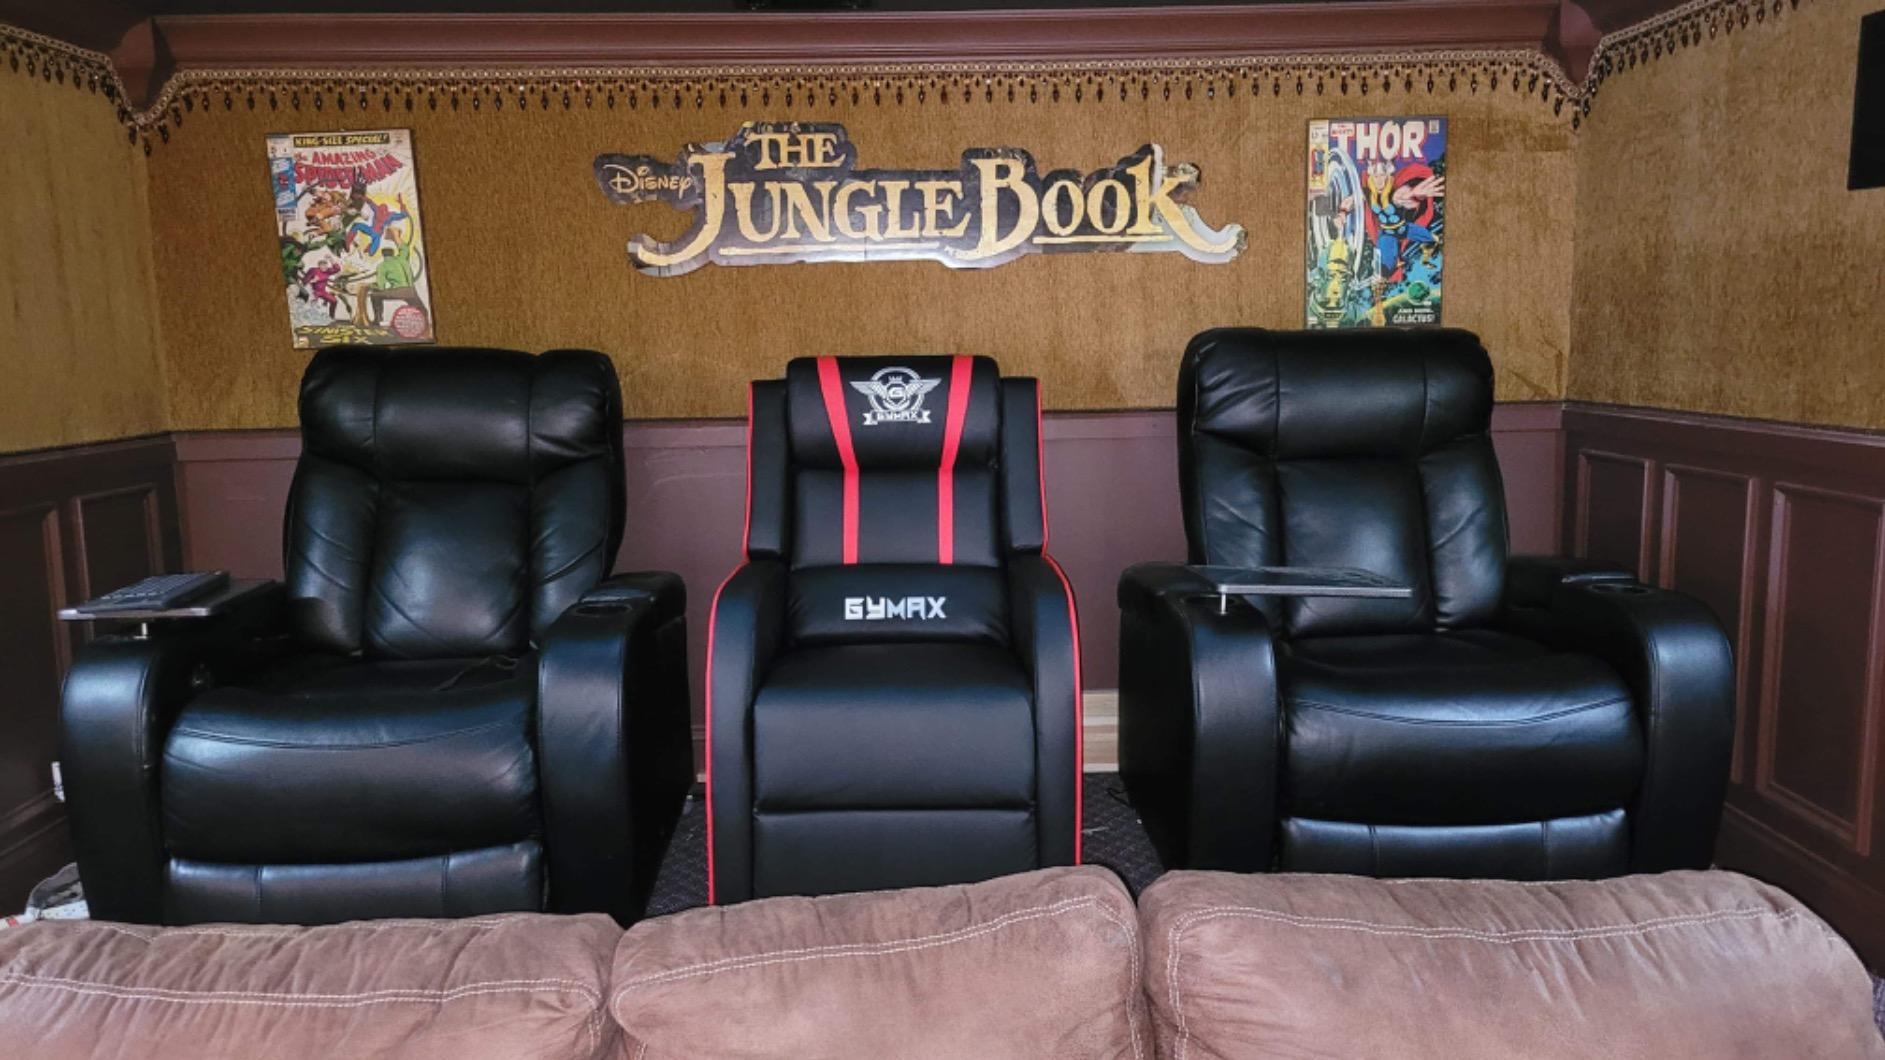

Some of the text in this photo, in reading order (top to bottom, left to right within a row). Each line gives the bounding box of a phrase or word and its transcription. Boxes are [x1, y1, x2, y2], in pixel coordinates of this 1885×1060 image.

[312, 149, 376, 165] AMAZING
[745, 132, 846, 170] THE
[1331, 120, 1426, 160] THOR
[293, 153, 403, 190] SPIDERMAN
[637, 152, 971, 266] JUNGLE
[844, 595, 947, 620] GYMAX
